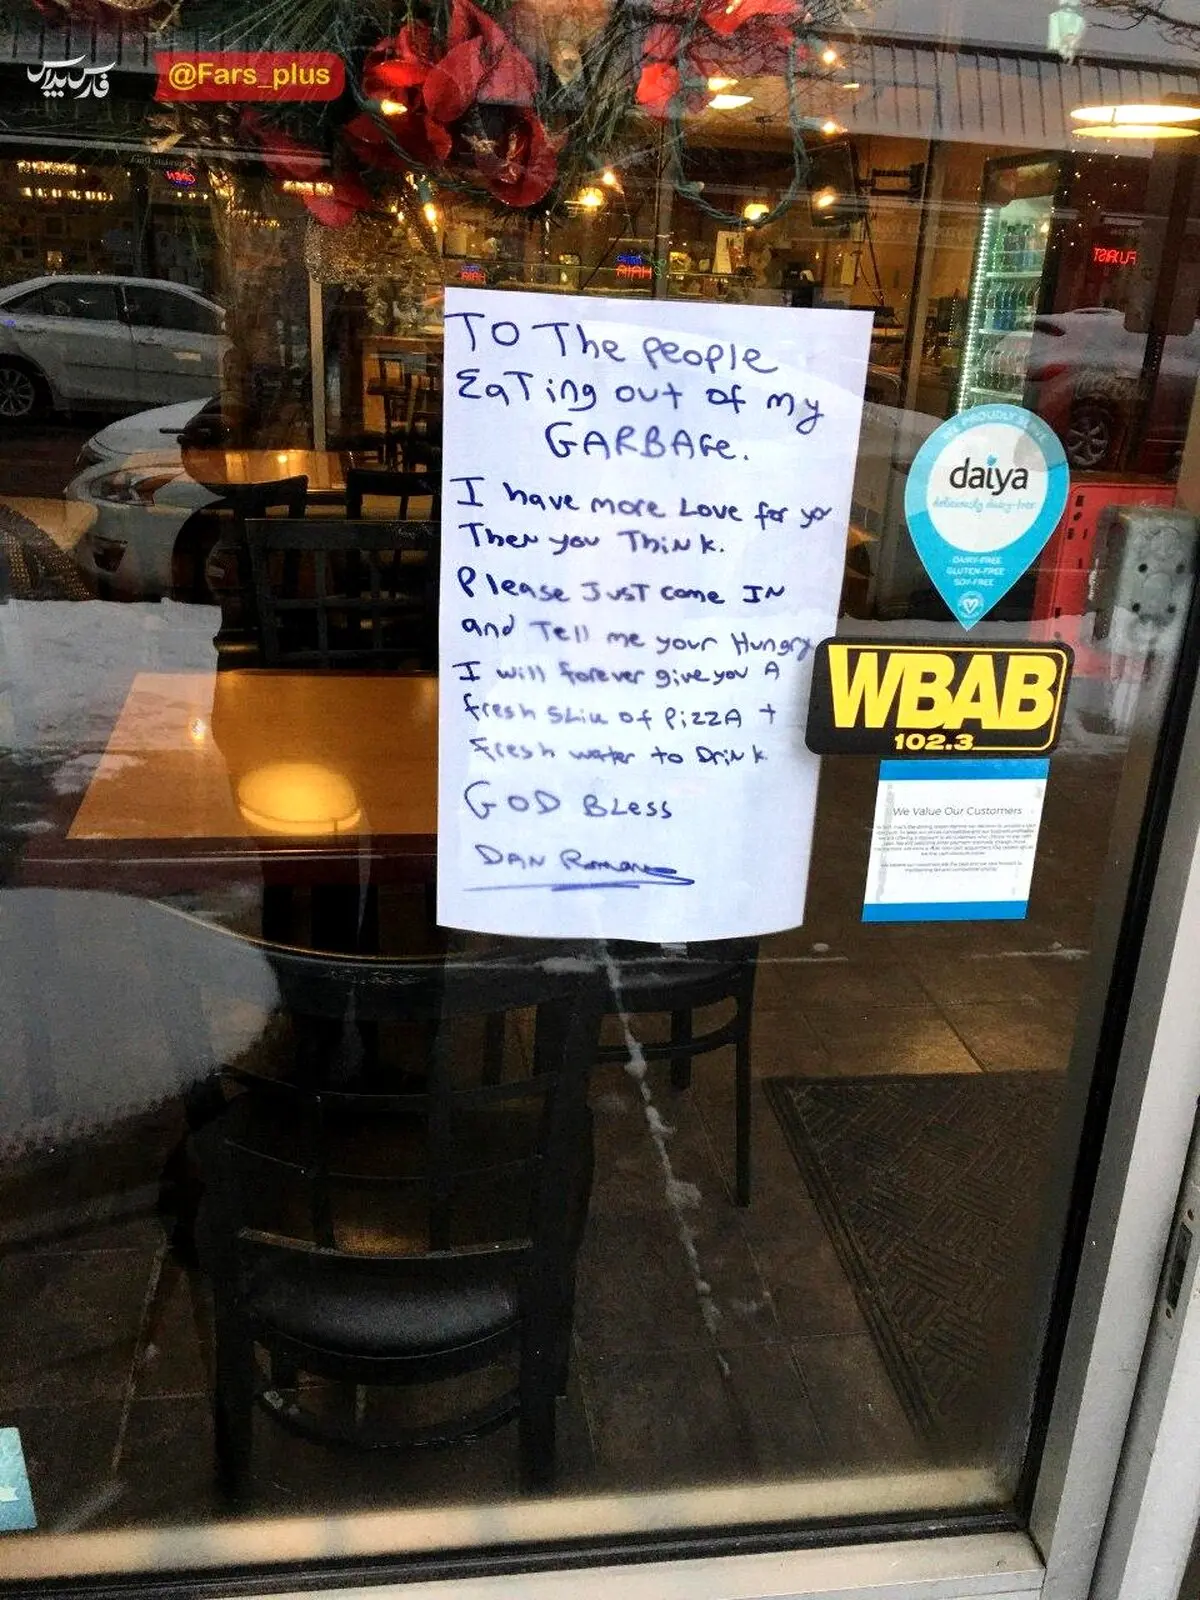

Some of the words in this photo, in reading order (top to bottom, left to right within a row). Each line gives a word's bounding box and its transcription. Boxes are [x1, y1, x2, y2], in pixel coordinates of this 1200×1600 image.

[445, 312, 520, 351] TO
[532, 321, 626, 363] The
[615, 381, 683, 409] out
[706, 384, 746, 414] of
[766, 393, 824, 434] my
[949, 454, 1029, 496] daiya
[450, 477, 485, 507] I
[503, 481, 580, 512] have
[591, 496, 665, 517] more
[679, 497, 743, 522] Love
[754, 501, 789, 531] for
[548, 534, 600, 555] you
[457, 566, 570, 602] Please
[661, 584, 726, 605] come
[743, 585, 785, 603] IN
[461, 614, 516, 638] and
[529, 620, 590, 642] Tell
[606, 631, 645, 649] me
[655, 635, 718, 655] your
[731, 631, 813, 662] Hungry
[453, 660, 481, 681] I
[496, 663, 546, 683] will
[558, 660, 645, 686] forever
[655, 667, 710, 689] give
[713, 666, 748, 686] you
[764, 660, 780, 680] A
[828, 645, 1057, 730] WBAB
[463, 692, 537, 722] fresh
[618, 708, 653, 731] of
[569, 744, 636, 766] water
[651, 744, 684, 765] to
[894, 733, 974, 750] 102.3
[463, 780, 560, 820] GOD
[893, 806, 910, 816] We
[912, 806, 942, 816] Value
[944, 806, 963, 816] Our
[966, 806, 1023, 816] Customers
[475, 843, 546, 869] DAN
